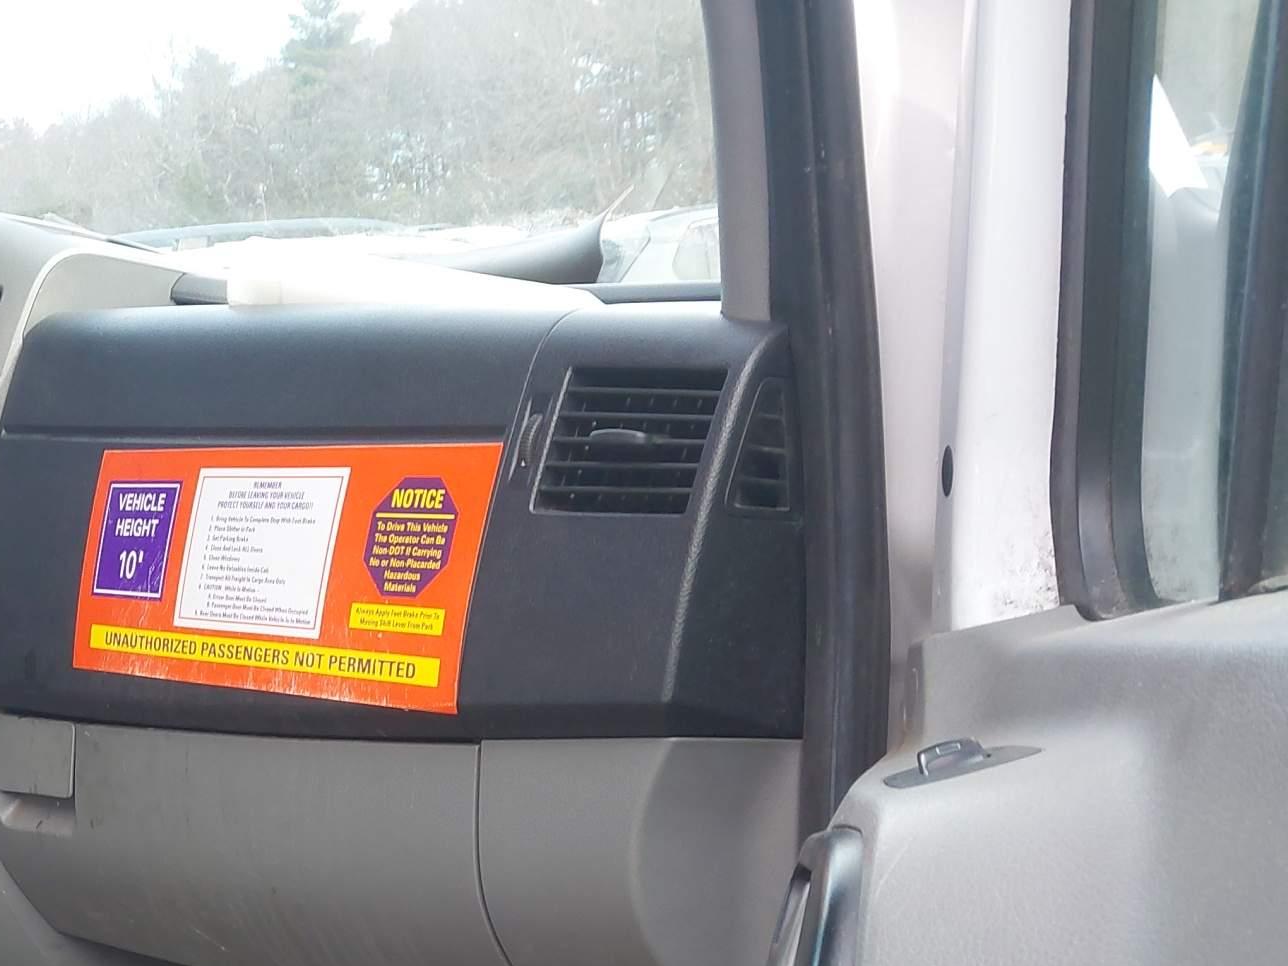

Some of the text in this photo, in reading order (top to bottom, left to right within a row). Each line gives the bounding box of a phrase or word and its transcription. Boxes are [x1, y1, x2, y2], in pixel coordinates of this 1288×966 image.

[229, 491, 304, 500] BEFORE LEAVING YOUR VEHICLE
[391, 488, 445, 509] NOTICE
[119, 493, 166, 512] VEHICLE
[218, 501, 238, 509] PROTECT
[240, 501, 263, 509] YOURSELF
[277, 502, 291, 510] YOUR
[115, 518, 159, 537] HEIGHT
[377, 521, 448, 533] To Drive This Vehicle
[375, 533, 445, 545] The Operator Can Be
[373, 545, 442, 559] Non-DOT If Carrying
[119, 549, 144, 580] 10'
[369, 557, 441, 570] No or Non-Placarded
[384, 569, 421, 581] Hazardous
[384, 581, 416, 593] Materials
[355, 607, 440, 620] Always Apply Foot Brake Prior To
[359, 617, 433, 631] Moving Shift Lever From Park
[105, 631, 416, 679] UNAUTHORIZED PASSENGERS NOT PERMITTED
